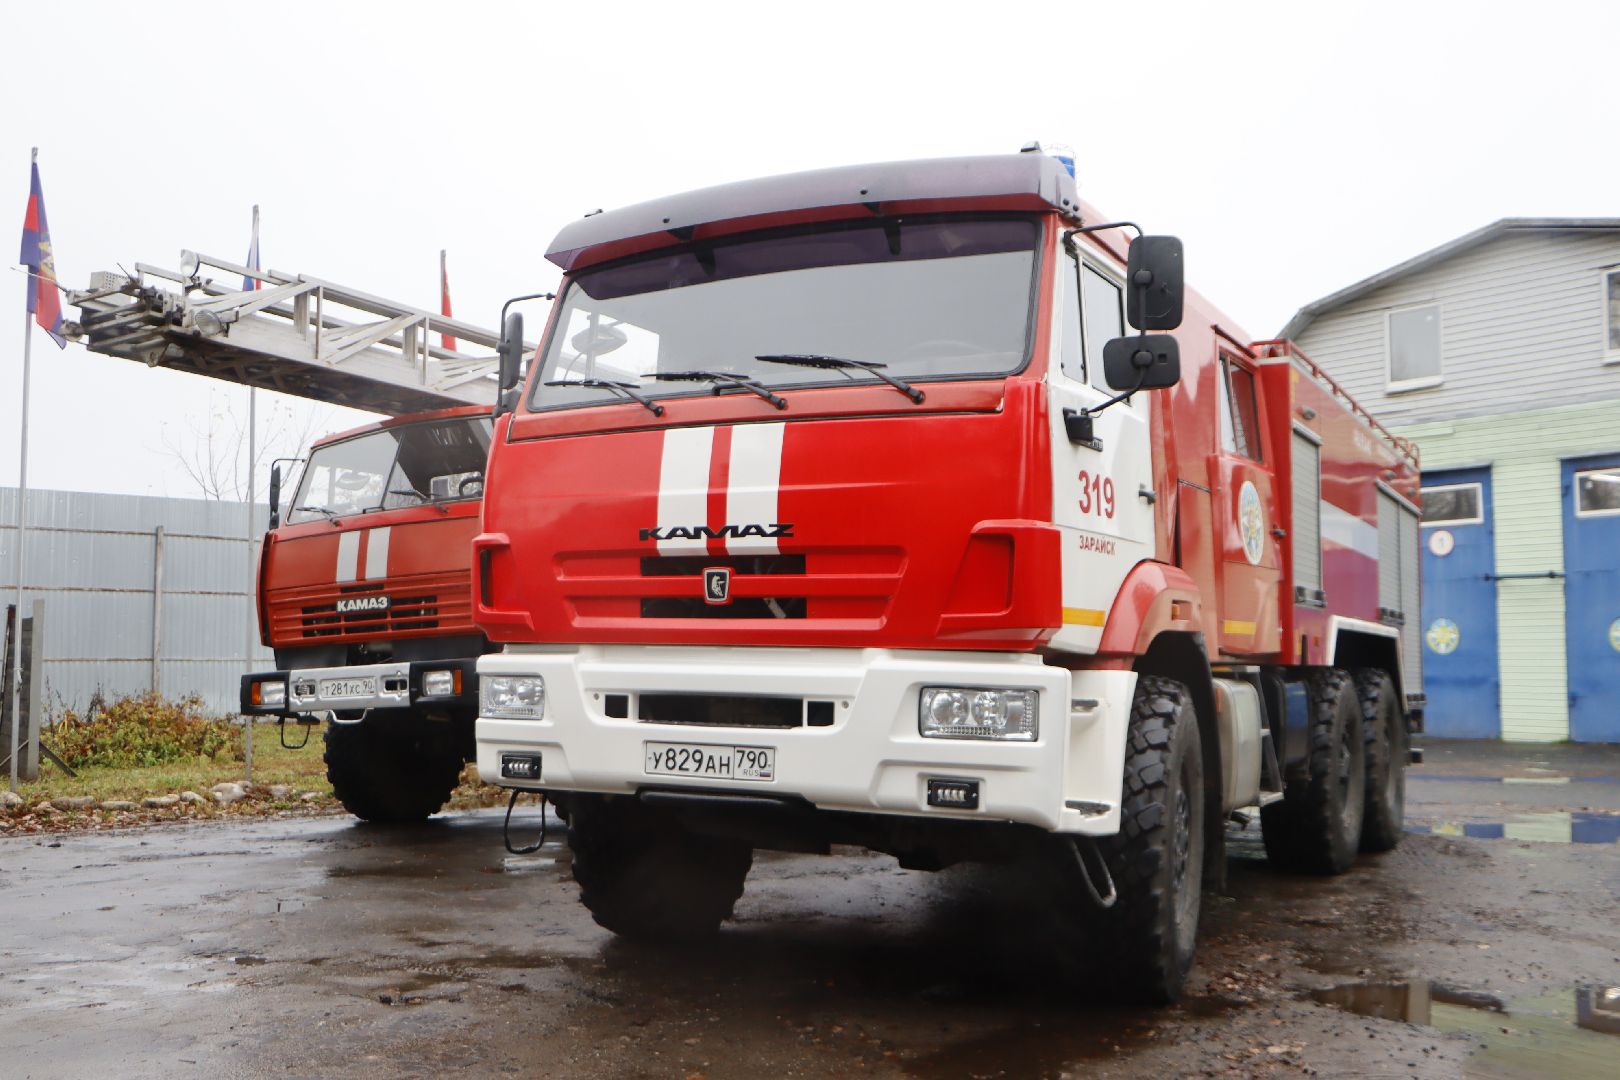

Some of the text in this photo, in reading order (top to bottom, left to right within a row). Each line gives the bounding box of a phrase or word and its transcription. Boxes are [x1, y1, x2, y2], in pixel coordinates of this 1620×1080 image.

[1078, 470, 1115, 519] 319
[639, 523, 795, 541] KAMAZ
[1079, 535, 1116, 555] ЗАРАЙСК
[337, 596, 388, 612] КАМАЗ
[653, 748, 768, 775] У829АН 790
[743, 769, 759, 777] RUS
